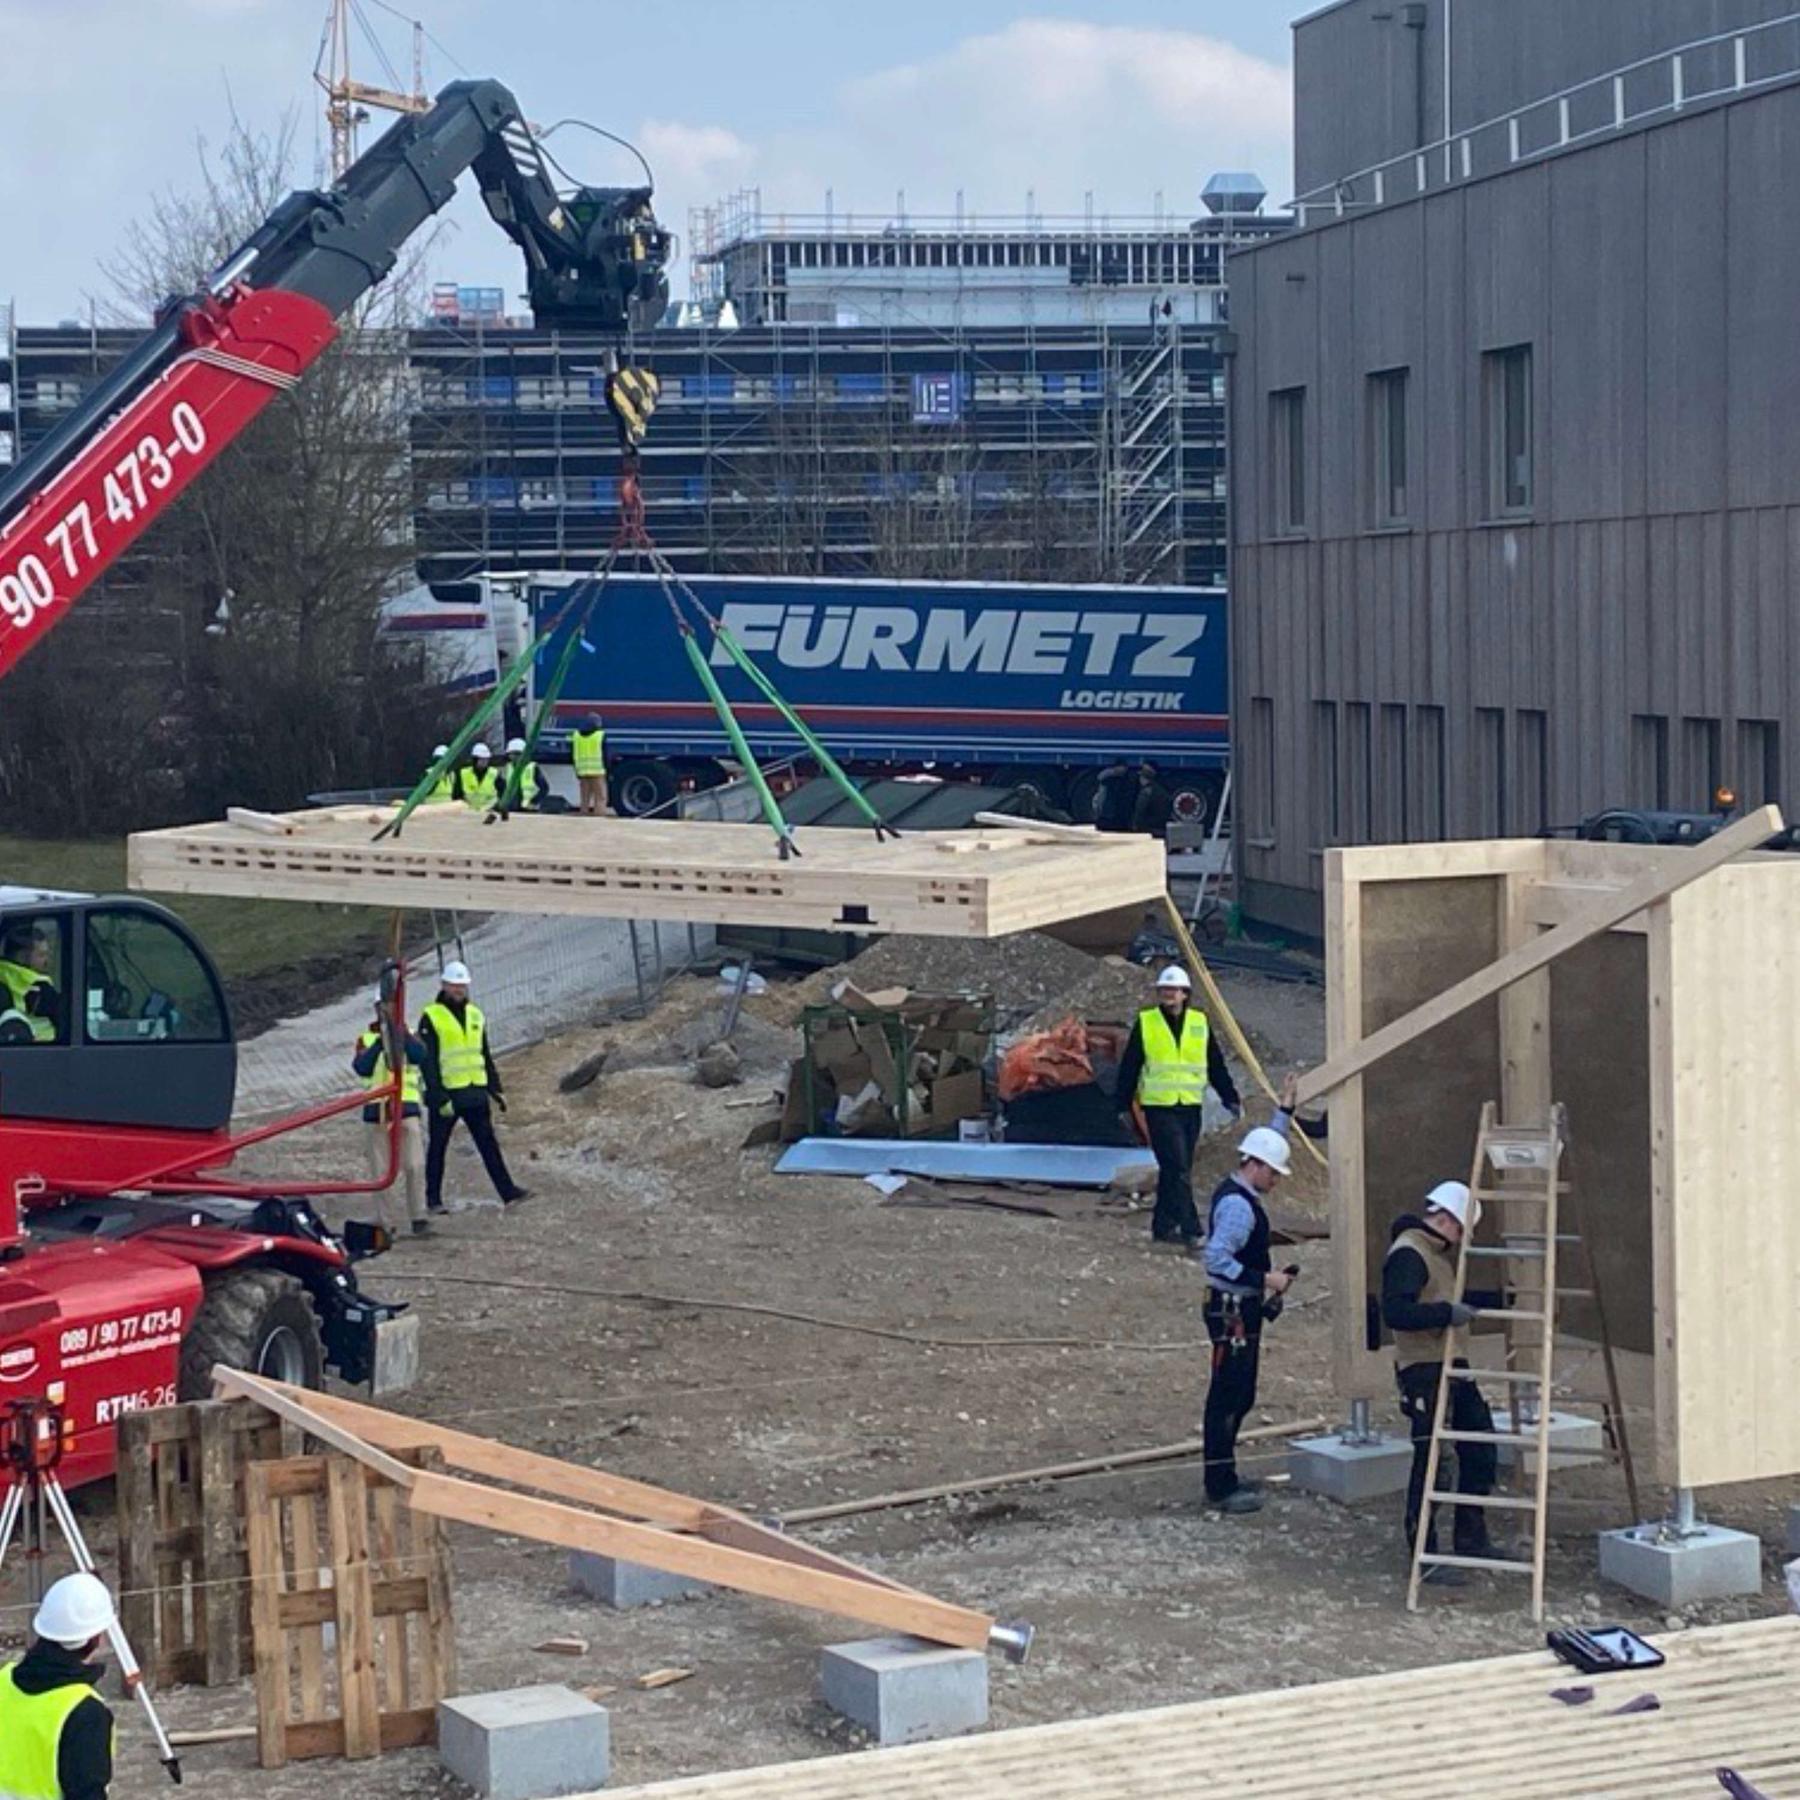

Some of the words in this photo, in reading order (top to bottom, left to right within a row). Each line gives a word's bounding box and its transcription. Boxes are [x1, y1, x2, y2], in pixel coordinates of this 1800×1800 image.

[0, 553, 55, 628] 90
[44, 501, 100, 578] 77
[103, 401, 207, 524] 473-0
[710, 602, 1207, 677] FÜRMETZ
[1061, 690, 1183, 711] LOGISTIK
[100, 1320, 119, 1344] 90
[121, 1316, 139, 1339] 77
[141, 1306, 182, 1334] 473-0
